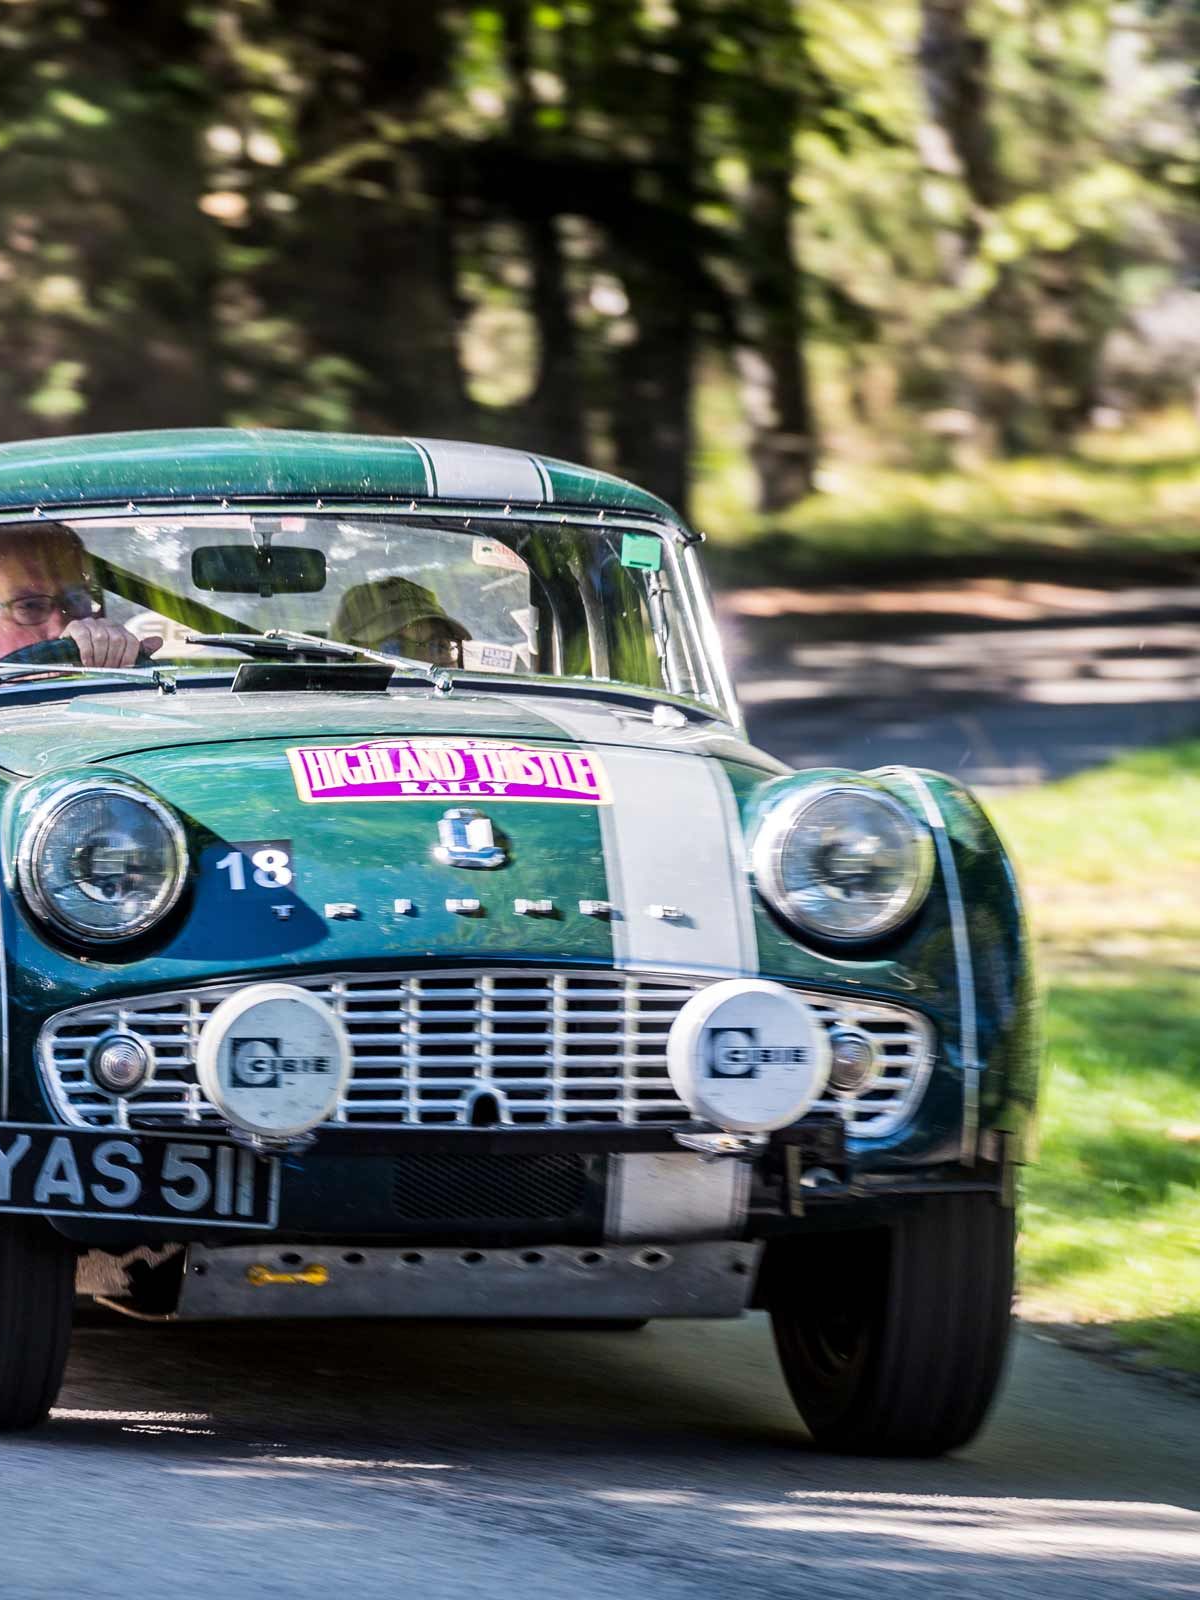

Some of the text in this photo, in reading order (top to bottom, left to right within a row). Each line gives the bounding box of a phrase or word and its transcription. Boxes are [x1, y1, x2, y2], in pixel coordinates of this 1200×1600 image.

[301, 748, 601, 796] HIGHLAND THISTLE
[400, 781, 512, 794] RALLY
[216, 849, 293, 890] 18
[160, 1143, 256, 1217] 511
